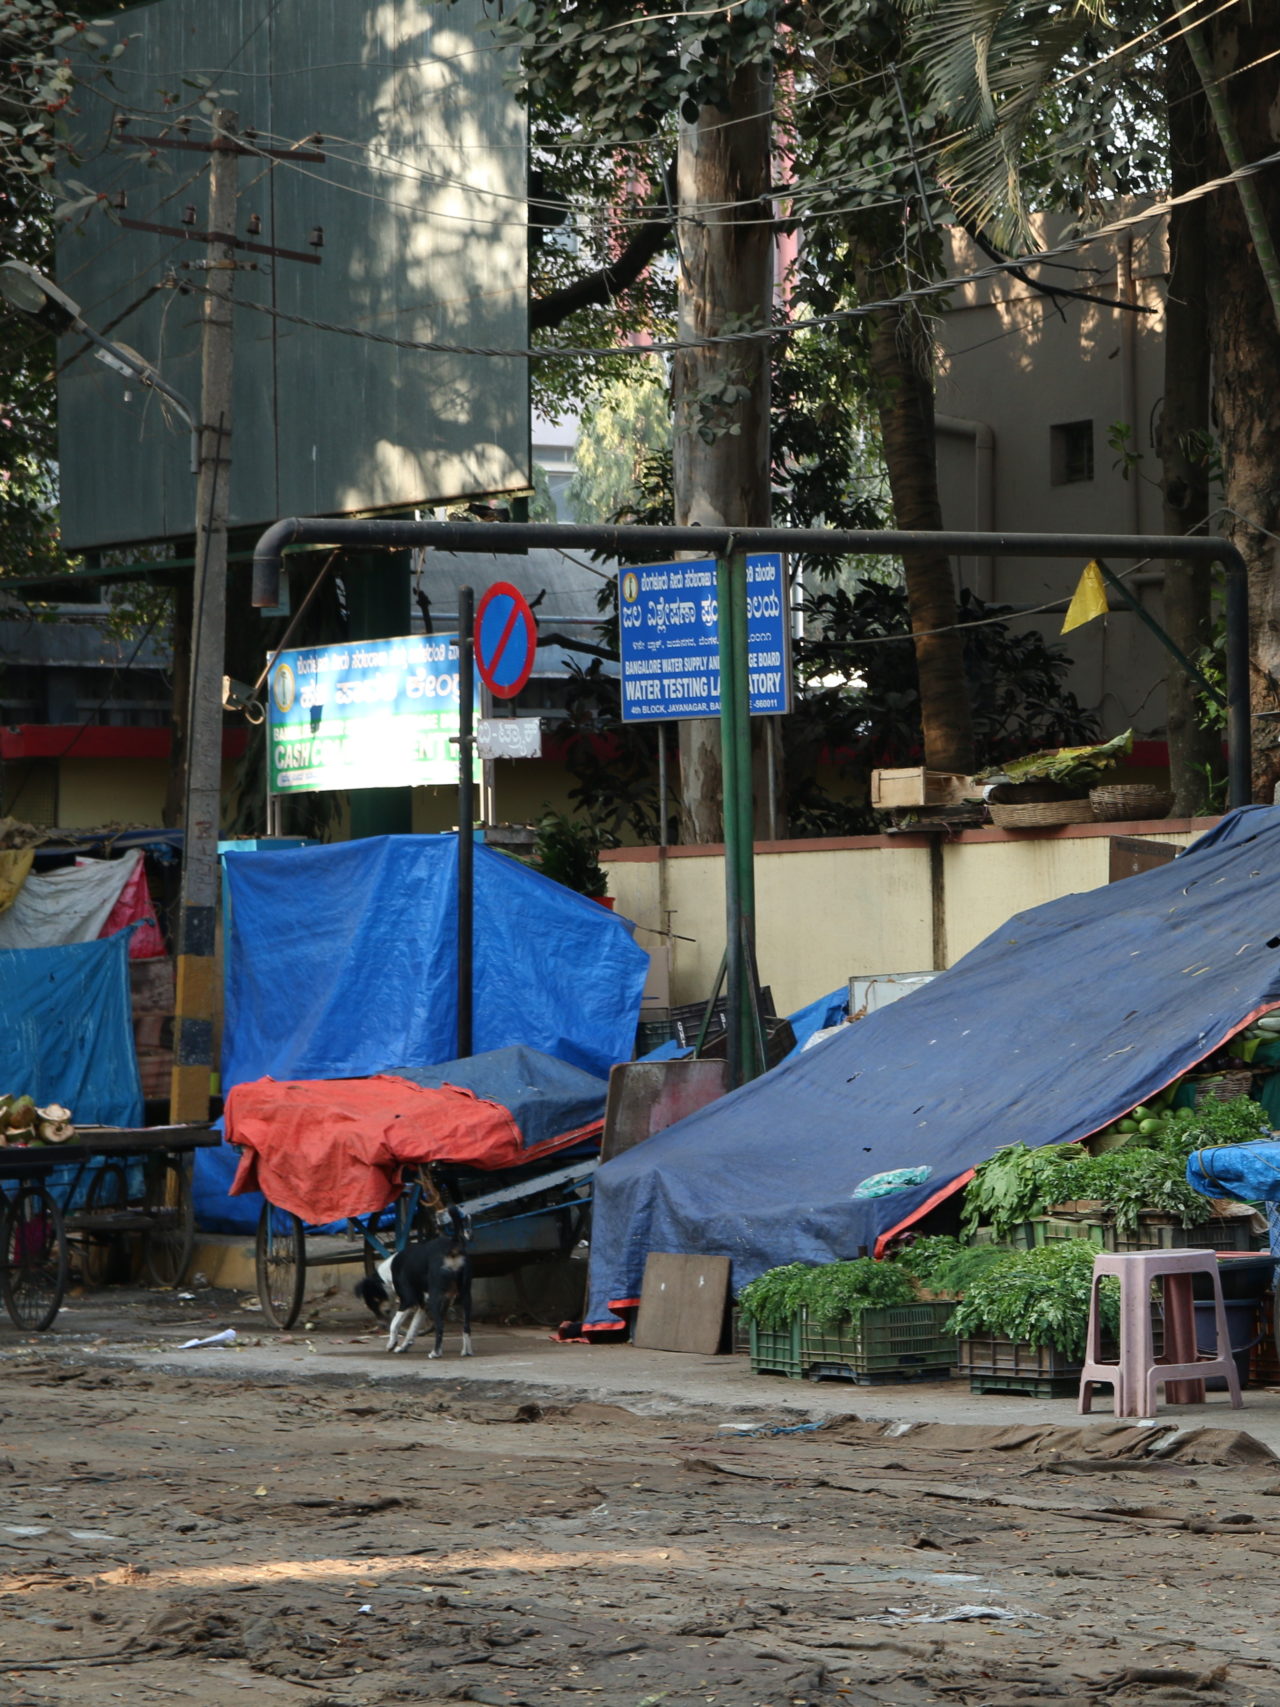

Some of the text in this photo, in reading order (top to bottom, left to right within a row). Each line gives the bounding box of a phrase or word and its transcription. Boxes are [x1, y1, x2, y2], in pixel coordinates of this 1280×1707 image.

[625, 659, 661, 675] BANGALORE
[662, 657, 683, 673] WATER
[684, 656, 707, 672] SUPPLY
[758, 652, 781, 667] BOARD
[625, 681, 661, 701] WATER
[663, 677, 708, 699] TESTING
